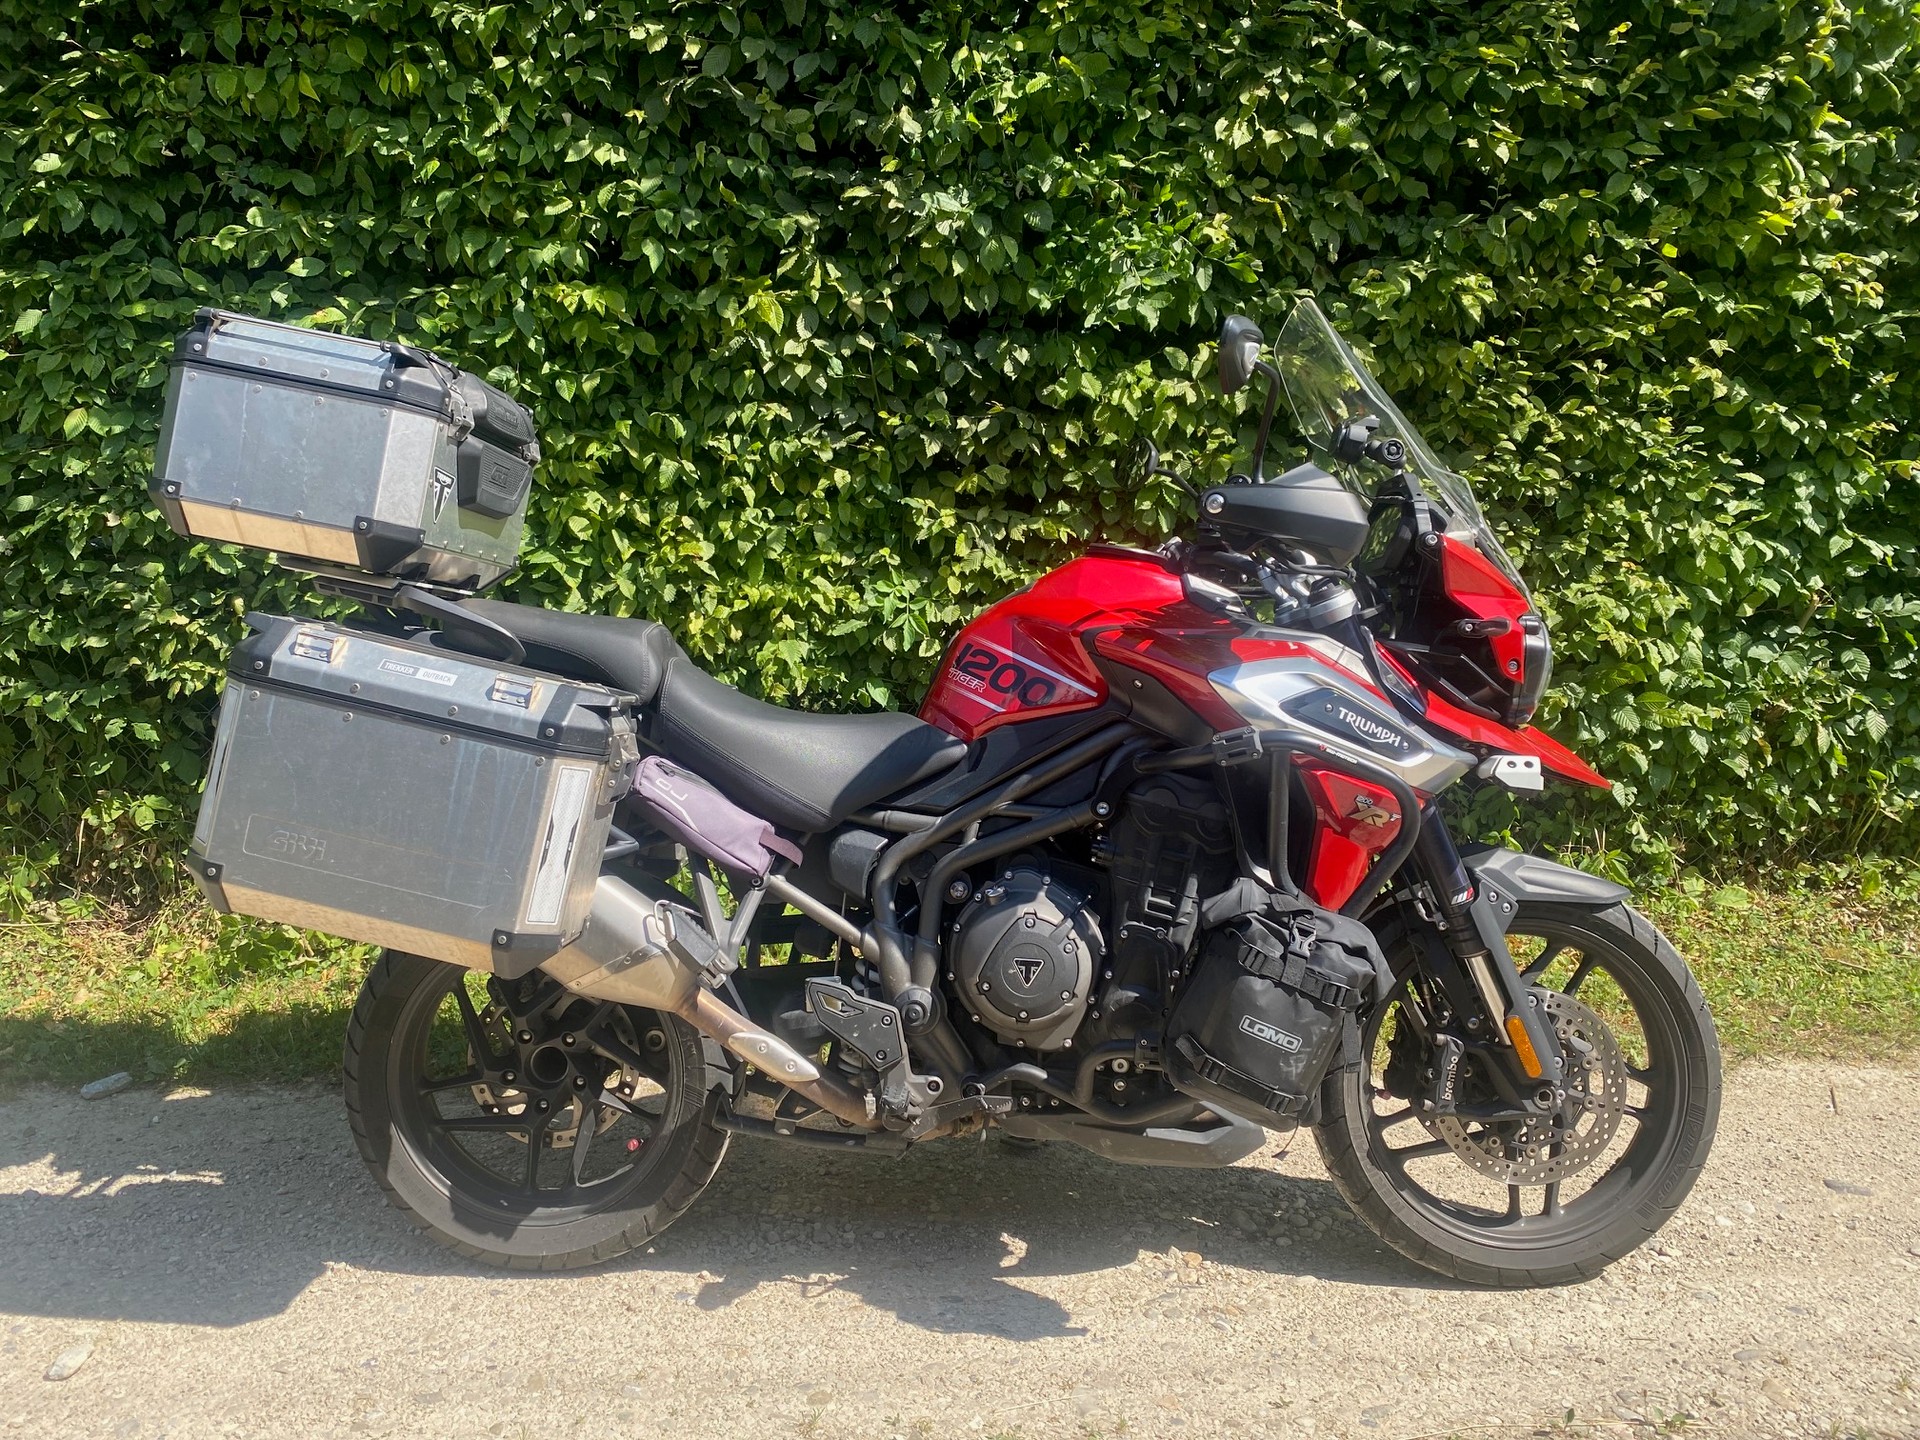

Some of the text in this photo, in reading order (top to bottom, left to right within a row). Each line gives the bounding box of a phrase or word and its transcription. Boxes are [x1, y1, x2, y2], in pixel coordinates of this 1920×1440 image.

[384, 662, 451, 683] TREKKER OUTBACK
[948, 667, 987, 693] TIGER
[955, 643, 1056, 706] 1200
[1339, 707, 1401, 747] TRIUMPH
[1242, 1018, 1299, 1050] LOMO
[1441, 1055, 1459, 1101] brembo
